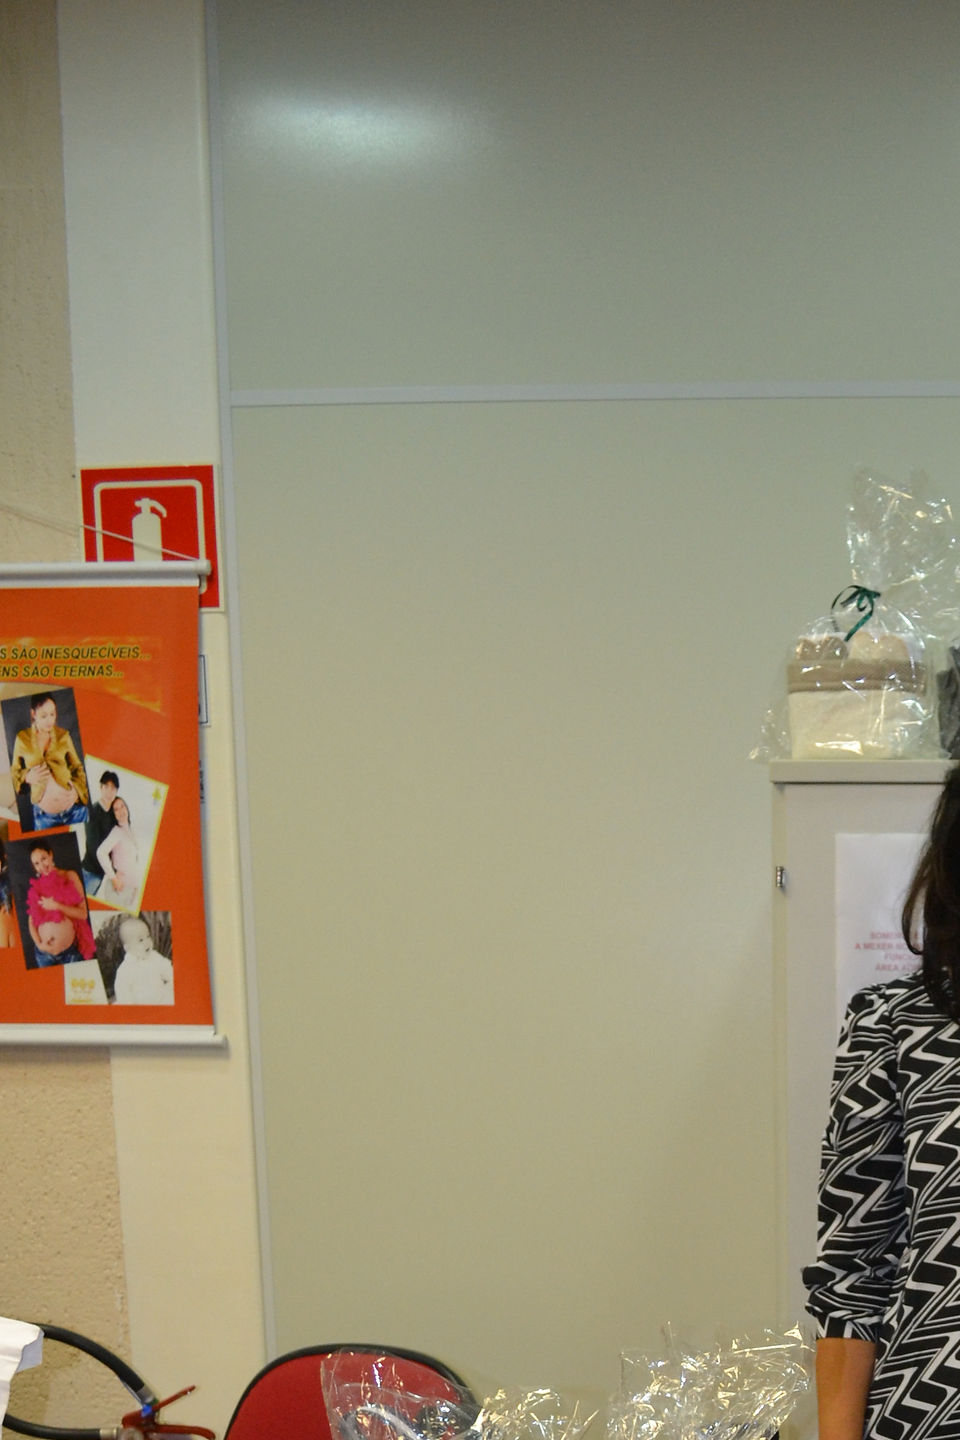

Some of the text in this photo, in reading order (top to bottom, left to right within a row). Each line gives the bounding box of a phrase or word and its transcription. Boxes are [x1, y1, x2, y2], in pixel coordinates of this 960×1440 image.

[11, 645, 38, 660] SÃO
[41, 645, 150, 659] INESQUECÍVEIS...
[22, 662, 50, 677] SÃO
[53, 664, 124, 678] ETERNAS...
